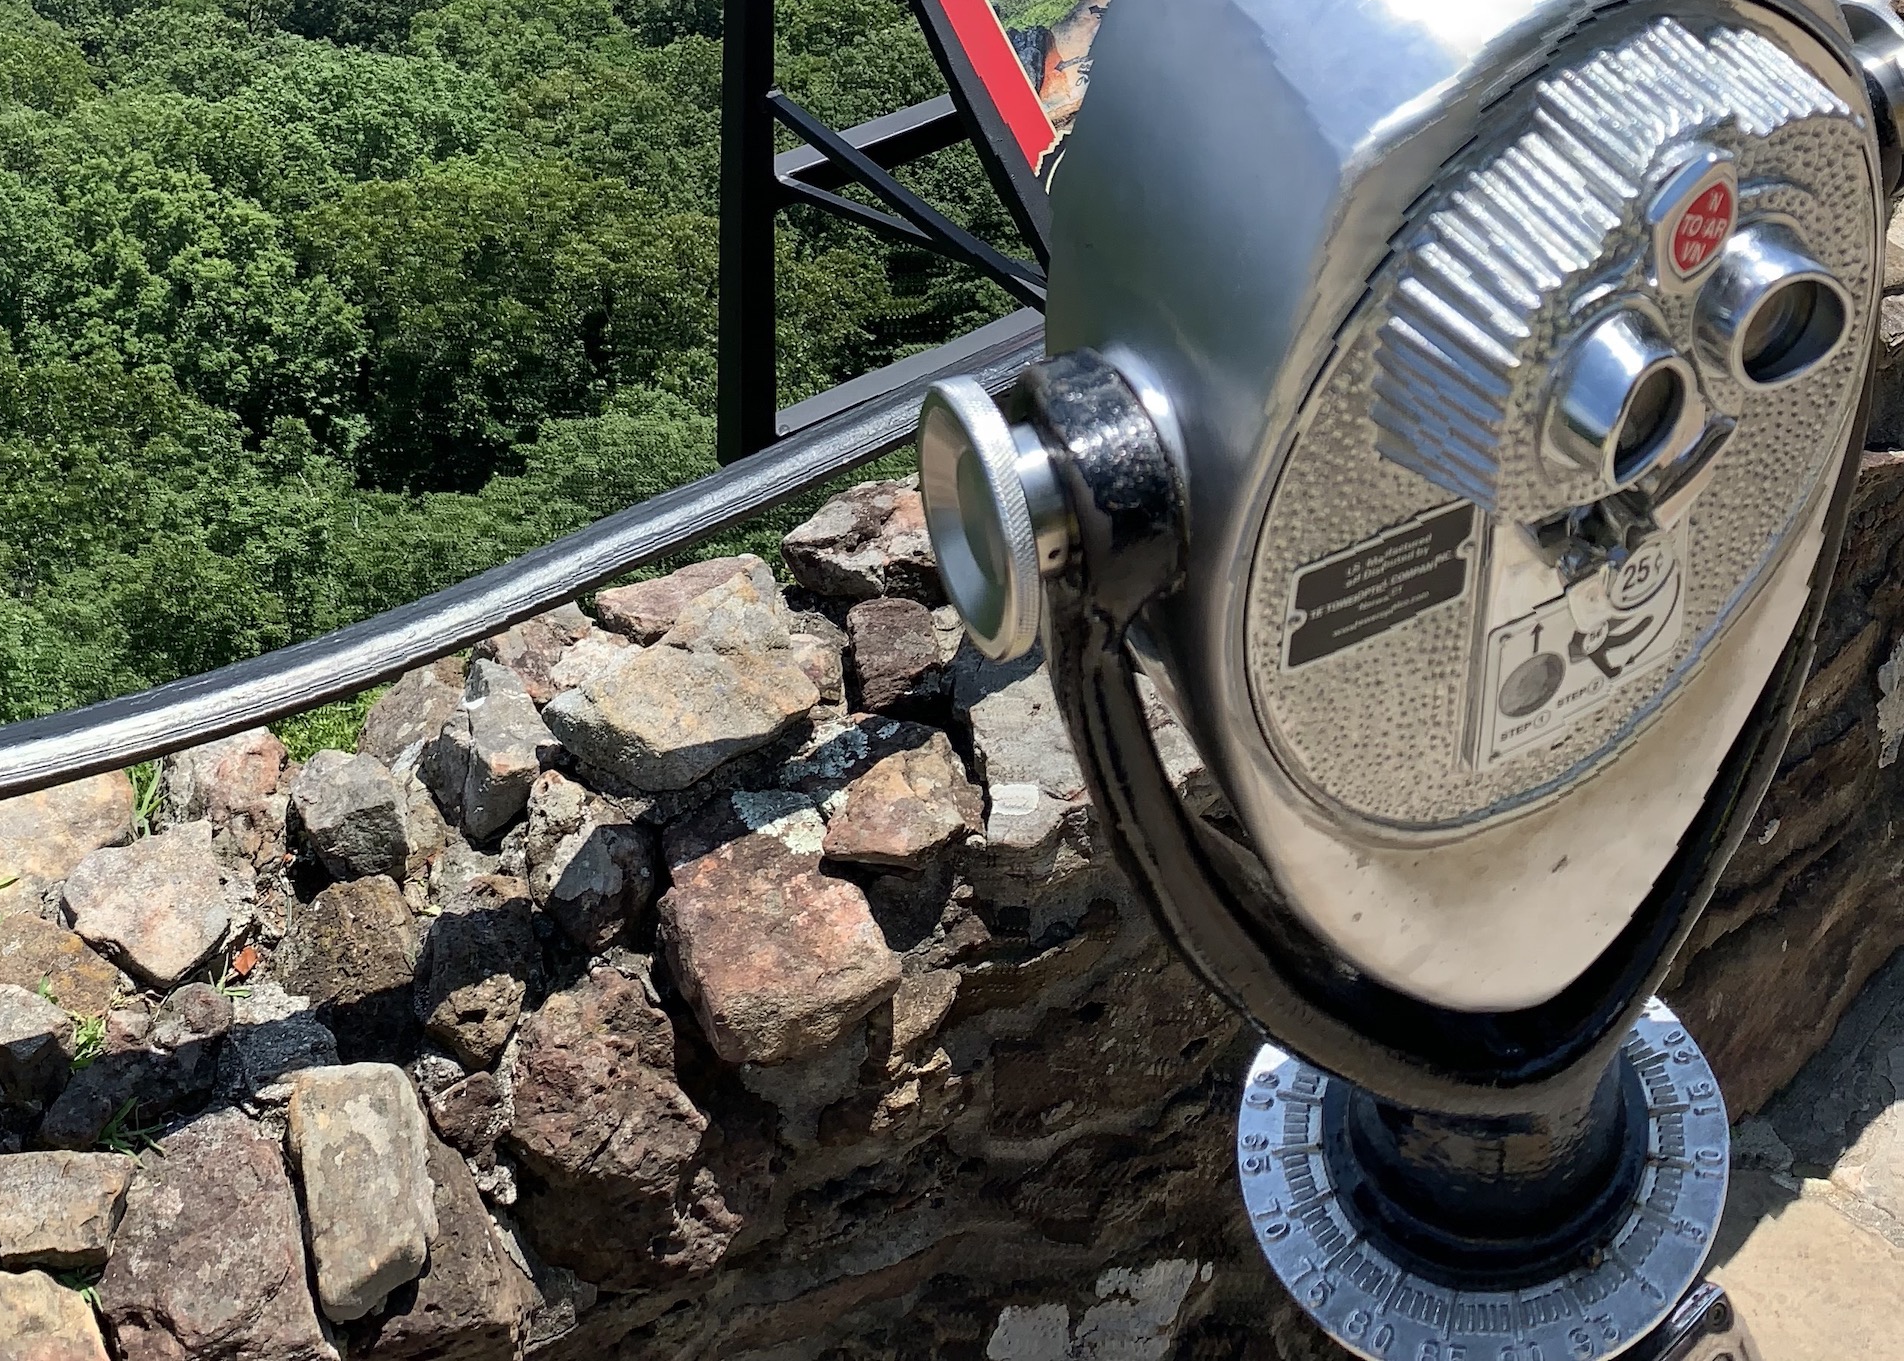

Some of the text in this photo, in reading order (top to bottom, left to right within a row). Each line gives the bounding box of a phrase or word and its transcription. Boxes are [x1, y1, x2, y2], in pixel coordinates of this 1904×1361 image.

[1557, 690, 1588, 709] STEP
[1501, 720, 1533, 743] STEP
[1342, 1309, 1394, 1353] 80
